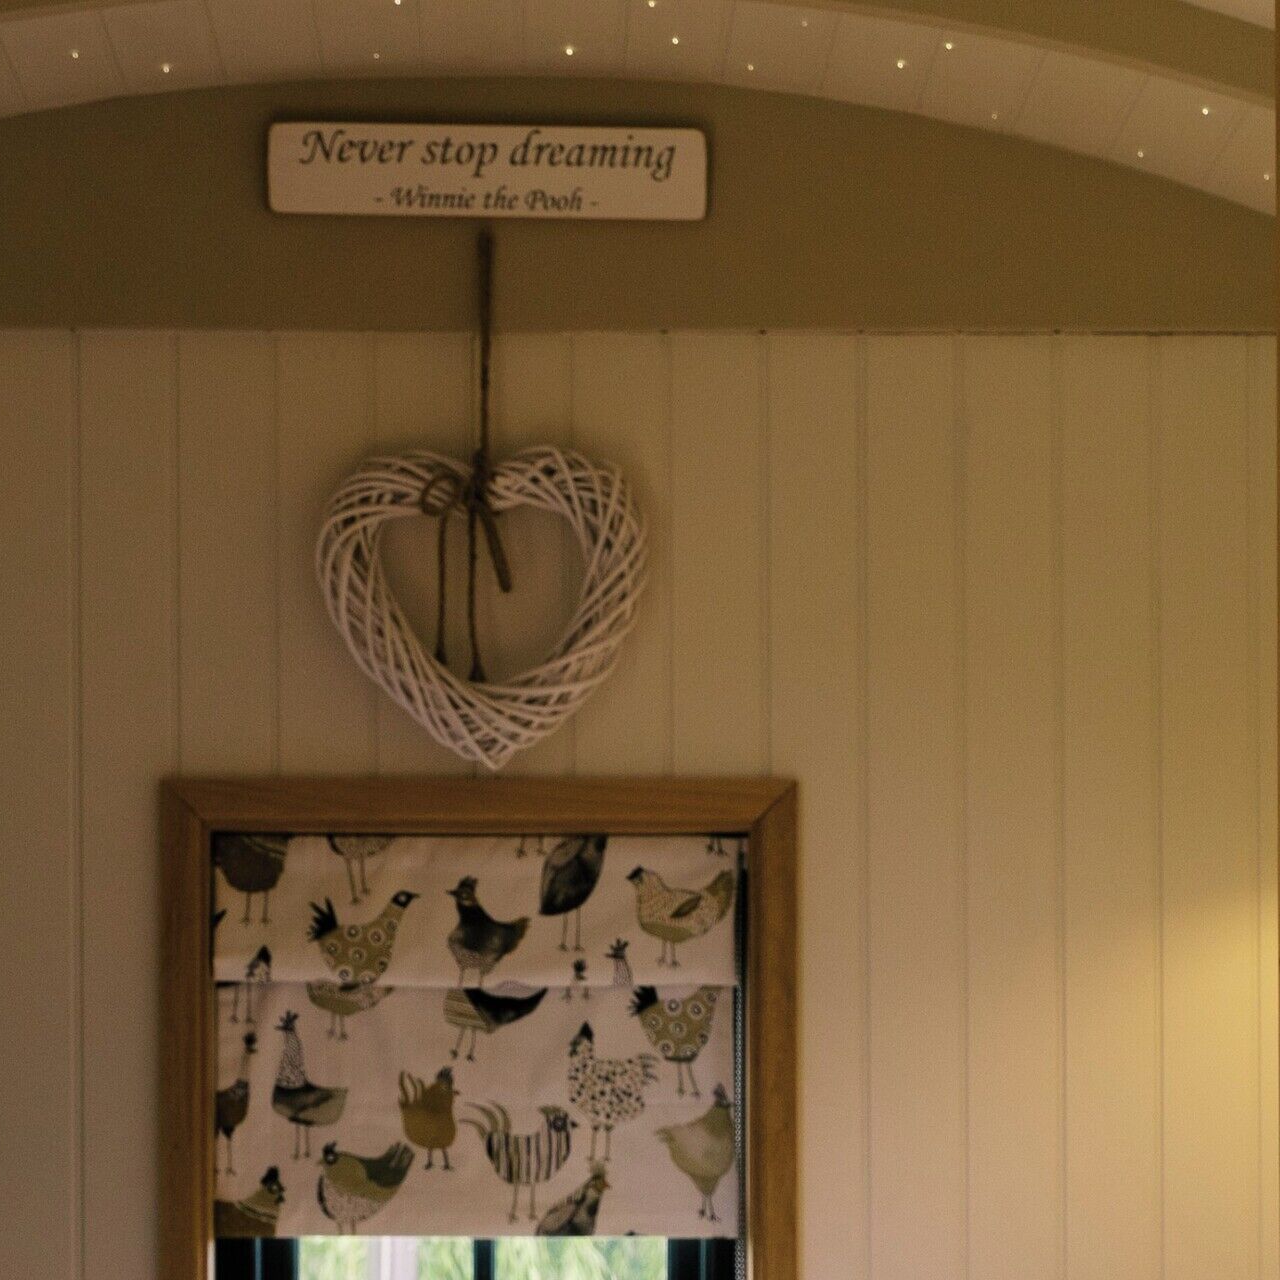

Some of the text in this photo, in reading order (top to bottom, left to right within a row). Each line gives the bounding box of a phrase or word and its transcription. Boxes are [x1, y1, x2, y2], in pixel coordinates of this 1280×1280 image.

[299, 129, 678, 182] Never stop dreaming
[390, 185, 584, 212] Winnie the Pooh
